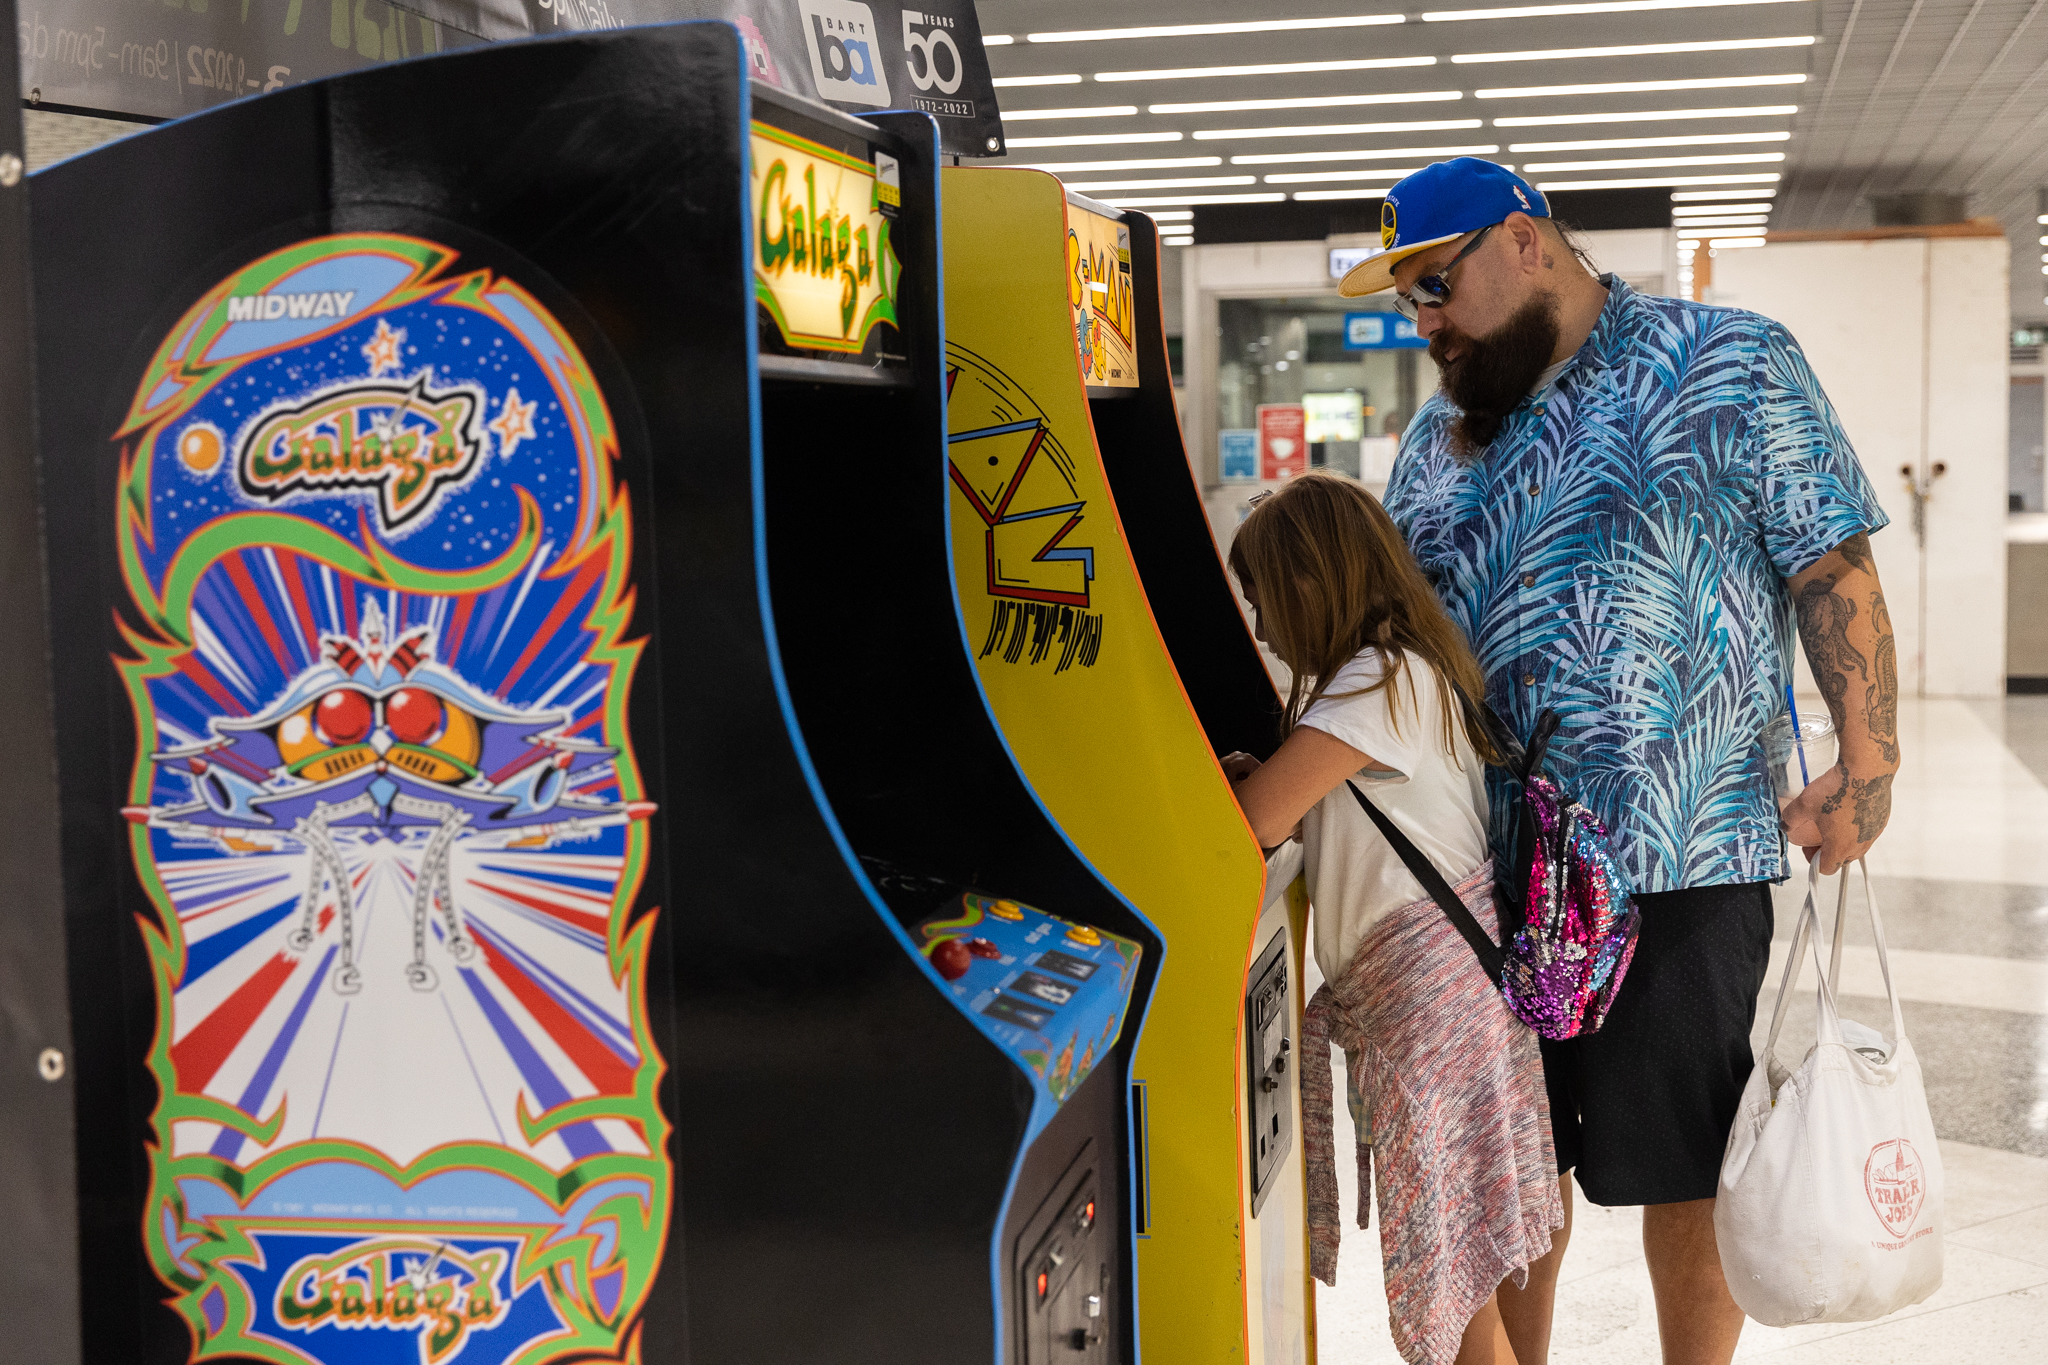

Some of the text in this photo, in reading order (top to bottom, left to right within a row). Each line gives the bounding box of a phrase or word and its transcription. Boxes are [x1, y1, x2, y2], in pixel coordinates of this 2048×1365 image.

[826, 17, 866, 35] BART
[923, 14, 955, 28] YEARS
[810, 13, 877, 86] ba
[902, 9, 963, 95] 50
[915, 99, 968, 115] 1972-2022
[760, 158, 876, 344] Galaga
[226, 290, 356, 322] MIDWAY
[249, 395, 467, 513] Galaga
[1915, 1226, 1933, 1239] STORE
[277, 1240, 503, 1364] Galaga
